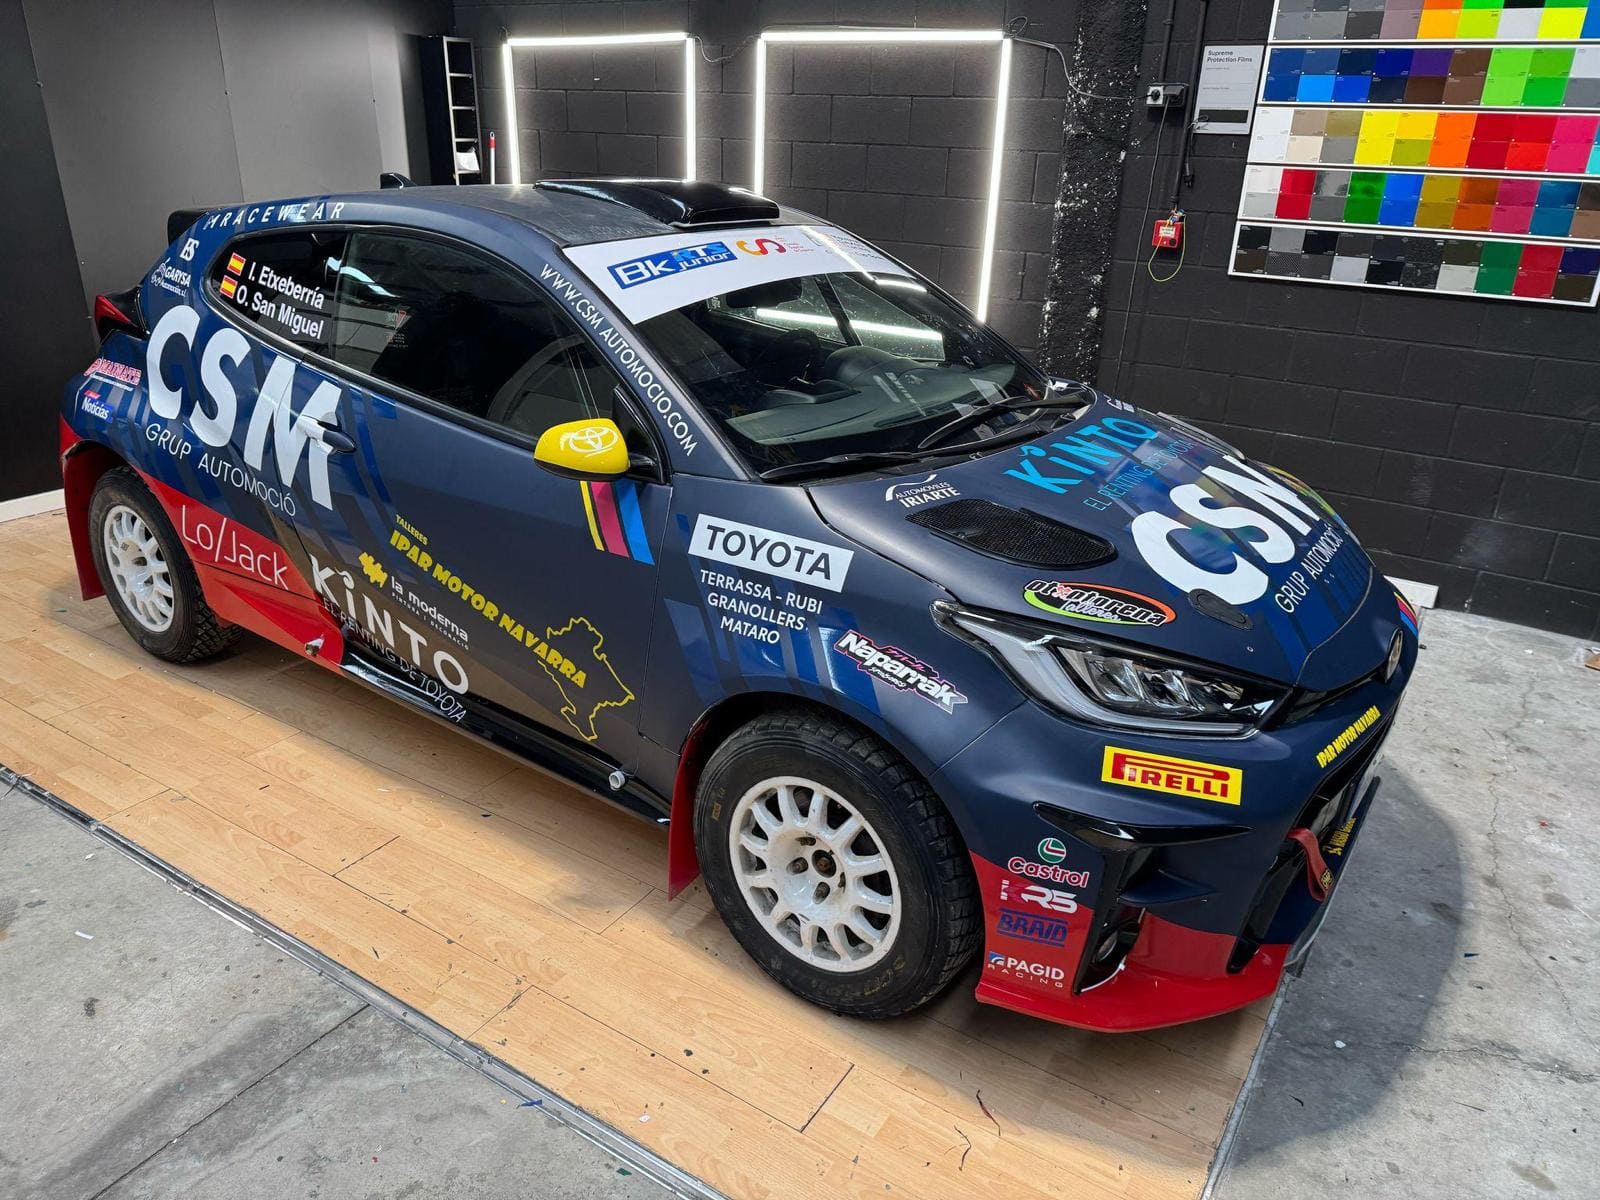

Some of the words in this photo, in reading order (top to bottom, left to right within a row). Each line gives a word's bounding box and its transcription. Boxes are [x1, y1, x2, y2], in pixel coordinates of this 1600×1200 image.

[247, 261, 256, 281] I.
[258, 265, 325, 309] Etxeberría
[236, 285, 248, 307] O.
[251, 291, 276, 319] San
[277, 303, 324, 340] Miguel
[146, 305, 342, 511] CSM
[145, 423, 192, 460] GRUP
[197, 452, 296, 517] AUTOMOCIÓ
[899, 486, 961, 508] IRIARTE
[396, 514, 428, 545] TALLERES
[705, 524, 832, 580] TOYOTA
[1131, 455, 1320, 605] CSM
[390, 530, 433, 572] IPAR
[432, 563, 501, 622] MOTOR
[498, 612, 588, 689] NAVARRA
[391, 575, 403, 595] la
[408, 591, 469, 643] moderna
[700, 568, 771, 600] TERRASSA
[786, 591, 823, 615] RUBI
[1275, 571, 1310, 613] GRUP
[720, 617, 780, 645] MATARO
[340, 611, 396, 662] RENTING
[420, 672, 467, 723] TOYOTA
[838, 632, 959, 706] Naparrak
[1316, 744, 1338, 769] IPAR
[1332, 725, 1358, 754] MOTOR
[1111, 752, 1231, 798] PIRELLI
[1008, 856, 1090, 888] Castrol
[997, 914, 1068, 942] BRAID
[988, 963, 1064, 988] RACING
[1006, 956, 1065, 980] PAGID
